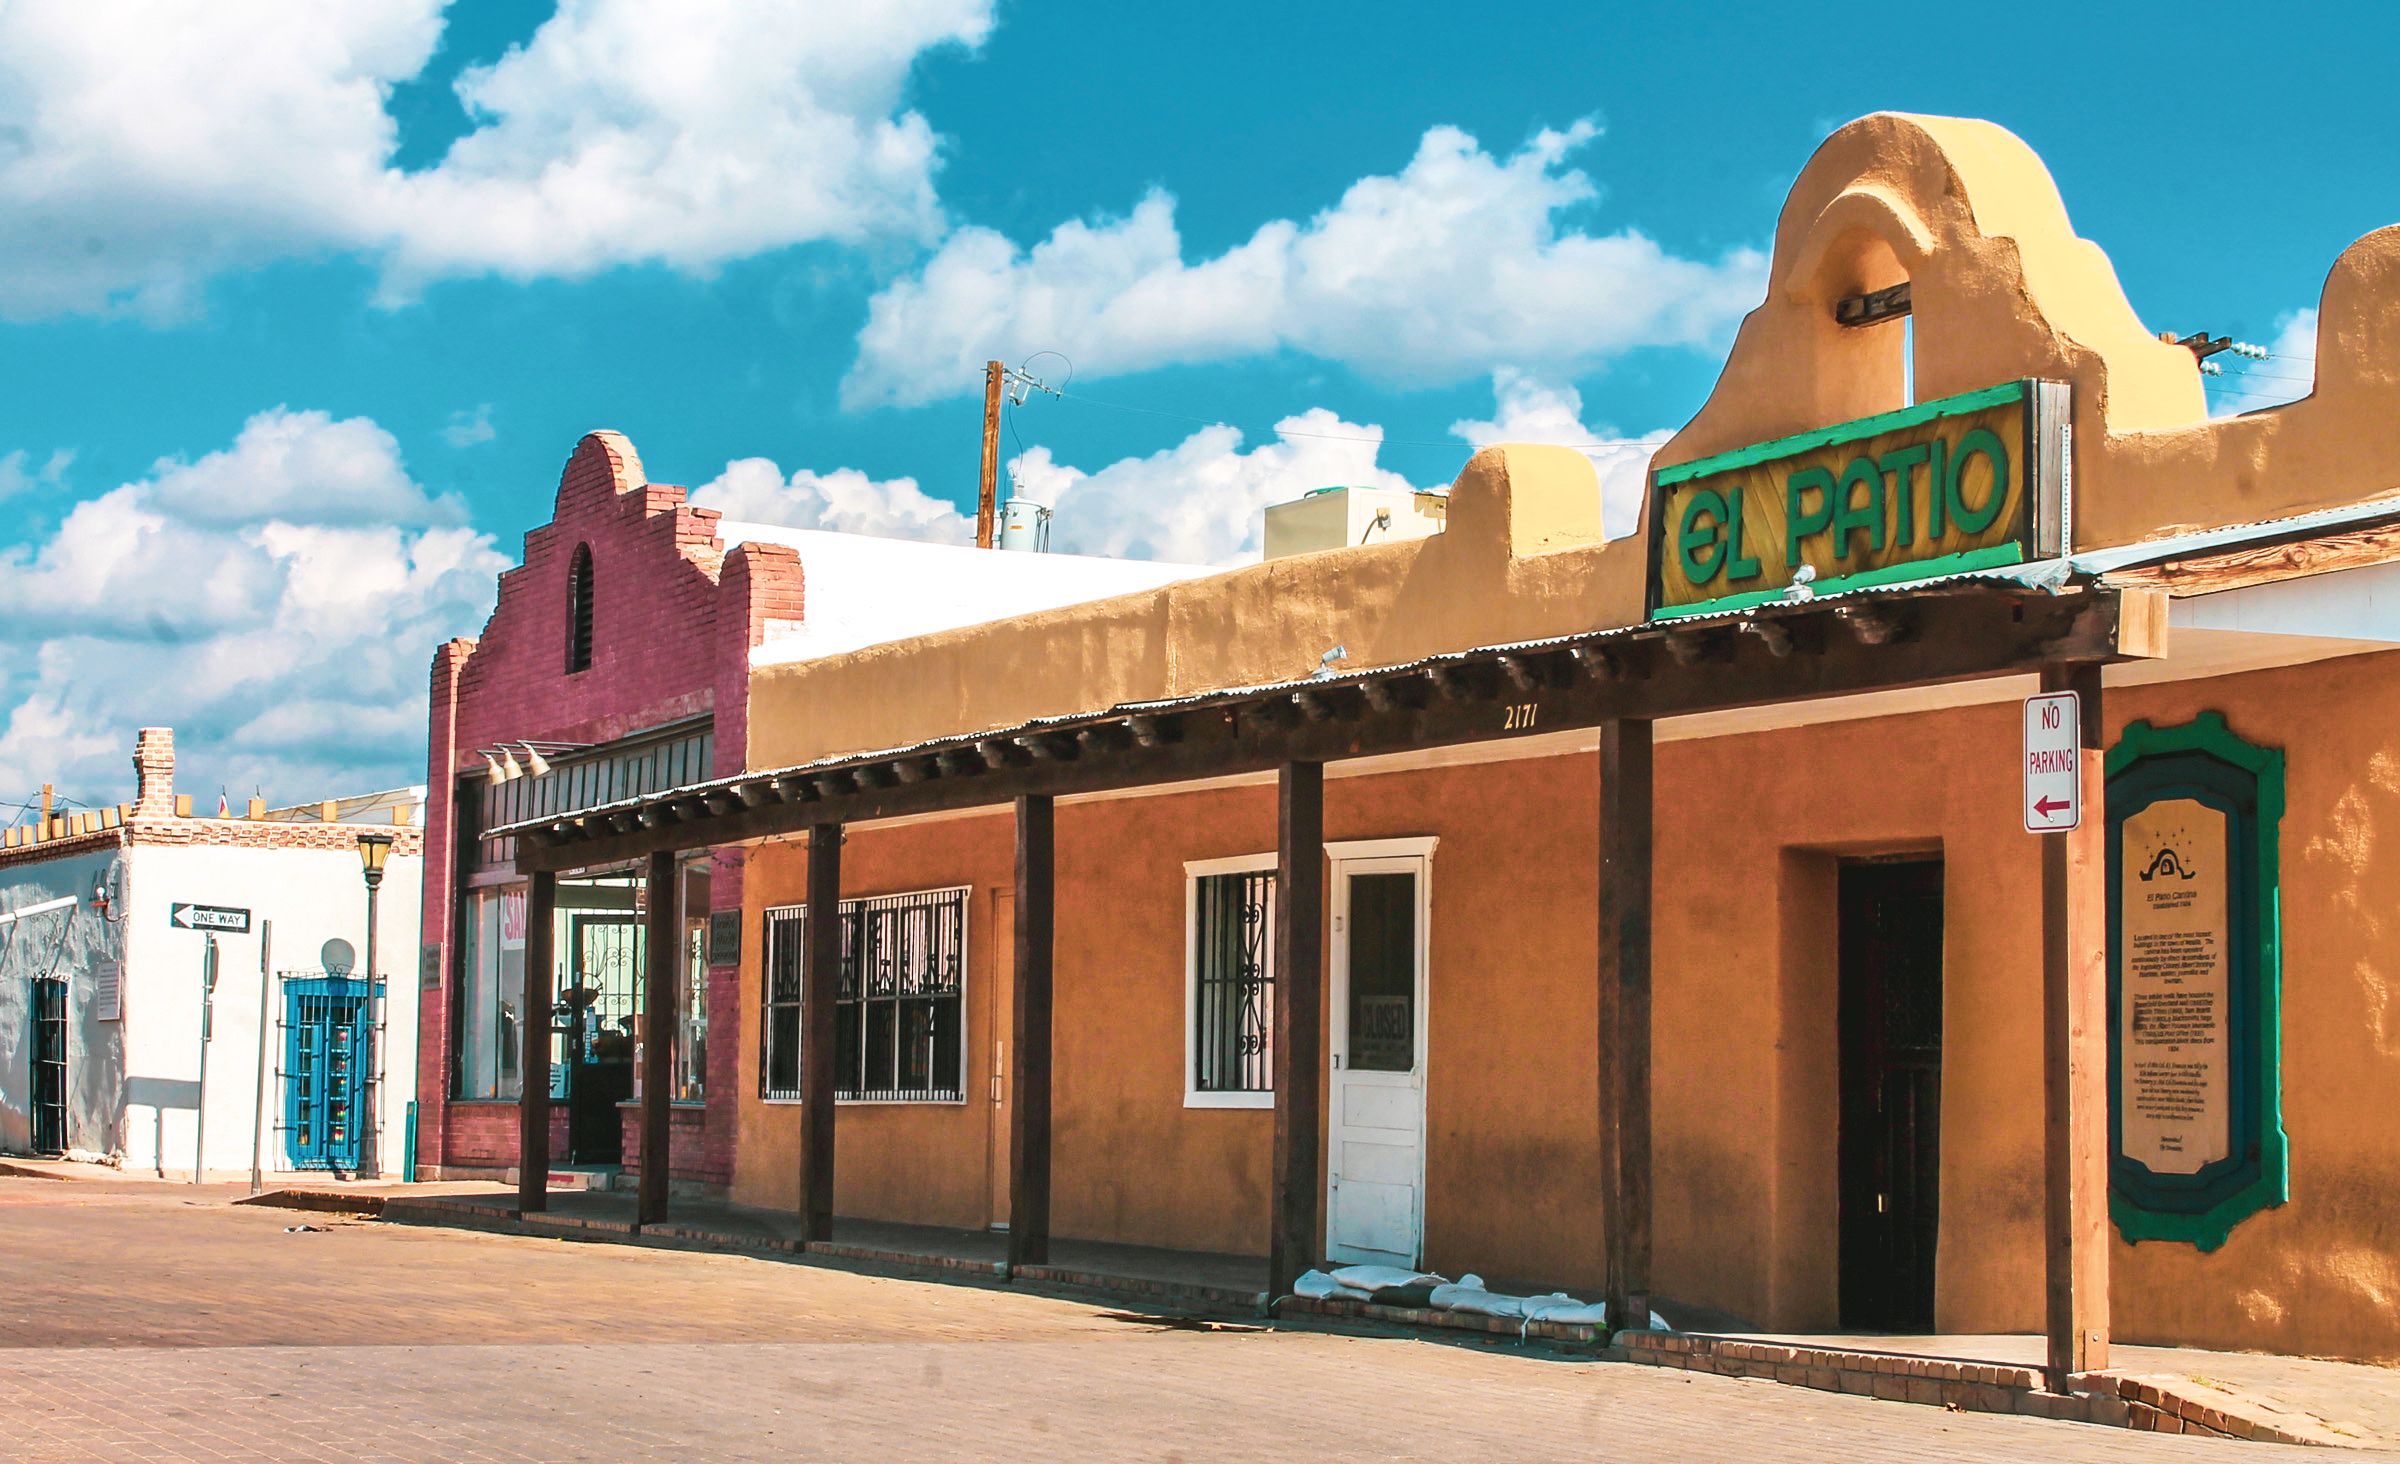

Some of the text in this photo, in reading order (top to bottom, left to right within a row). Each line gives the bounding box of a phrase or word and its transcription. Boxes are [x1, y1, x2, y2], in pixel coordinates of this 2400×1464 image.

[1786, 428, 2008, 567] PATIO
[1504, 703, 1538, 730] 2171
[2042, 705, 2060, 730] NO
[2029, 748, 2073, 774] PARKING
[193, 911, 240, 926] ONE WAY
[1363, 1003, 1406, 1040] CLOSED
